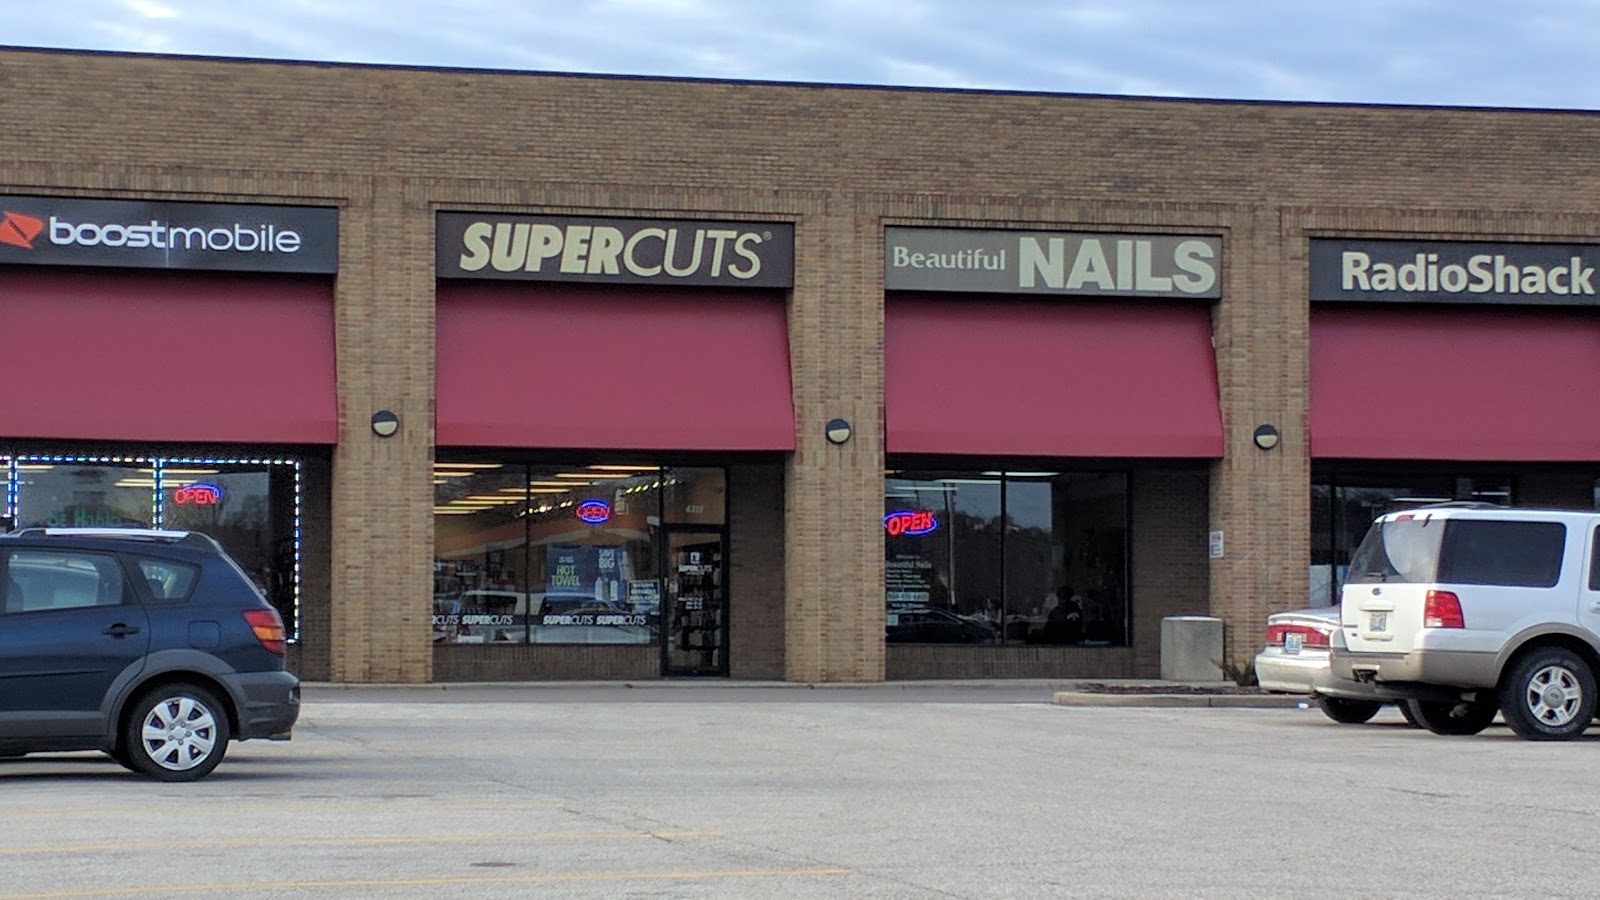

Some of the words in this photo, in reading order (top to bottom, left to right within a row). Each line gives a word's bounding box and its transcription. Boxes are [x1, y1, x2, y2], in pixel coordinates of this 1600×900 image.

[459, 222, 763, 279] SUPERCUTS
[892, 244, 1006, 273] Beautiful
[1018, 235, 1217, 295] NAILS
[1341, 250, 1596, 298] RadioShack
[174, 488, 217, 506] OPEN
[888, 511, 933, 536] OPEN
[556, 564, 576, 576] HOT
[551, 575, 581, 586] TOWEL
[461, 614, 514, 625] SUPERCUTS
[542, 615, 594, 625] SUPERCUTS
[596, 615, 647, 625] SUPERCUTS
